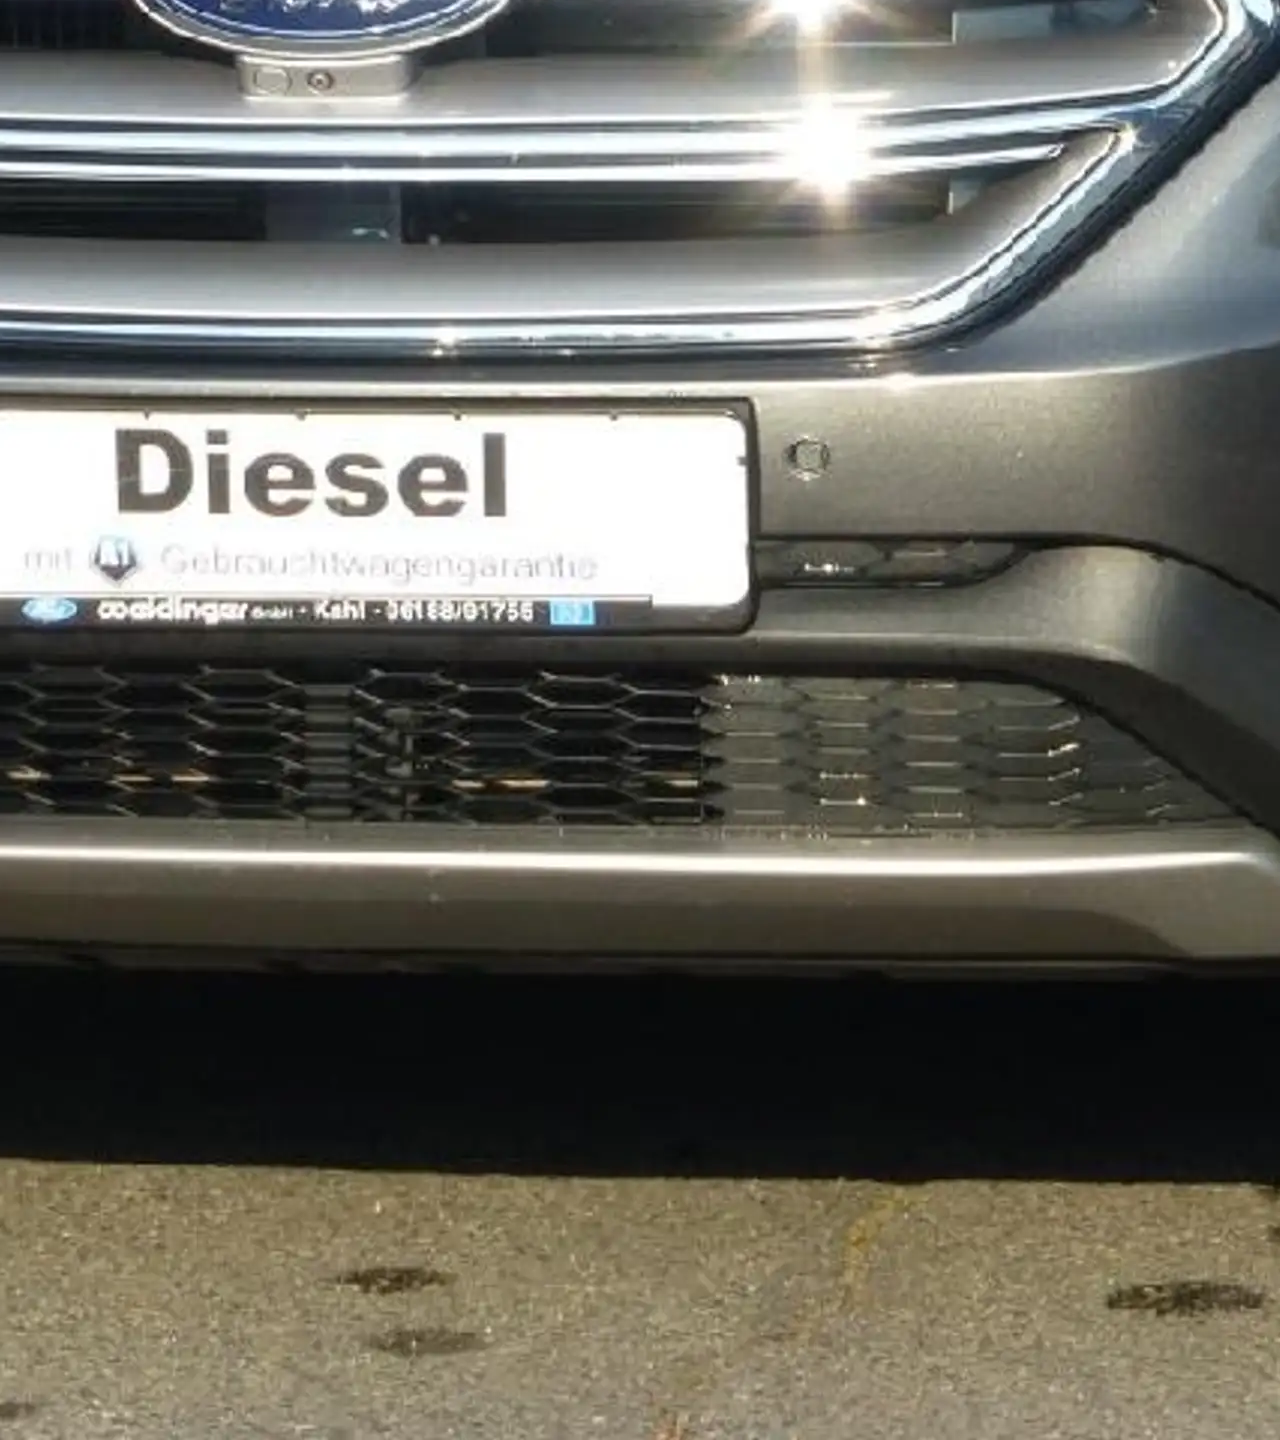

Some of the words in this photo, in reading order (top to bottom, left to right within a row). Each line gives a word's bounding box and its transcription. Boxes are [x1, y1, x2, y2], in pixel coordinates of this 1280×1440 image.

[114, 427, 508, 518] Diesel
[23, 545, 71, 572] mit
[161, 543, 600, 584] Gebrauchtwagengarantie
